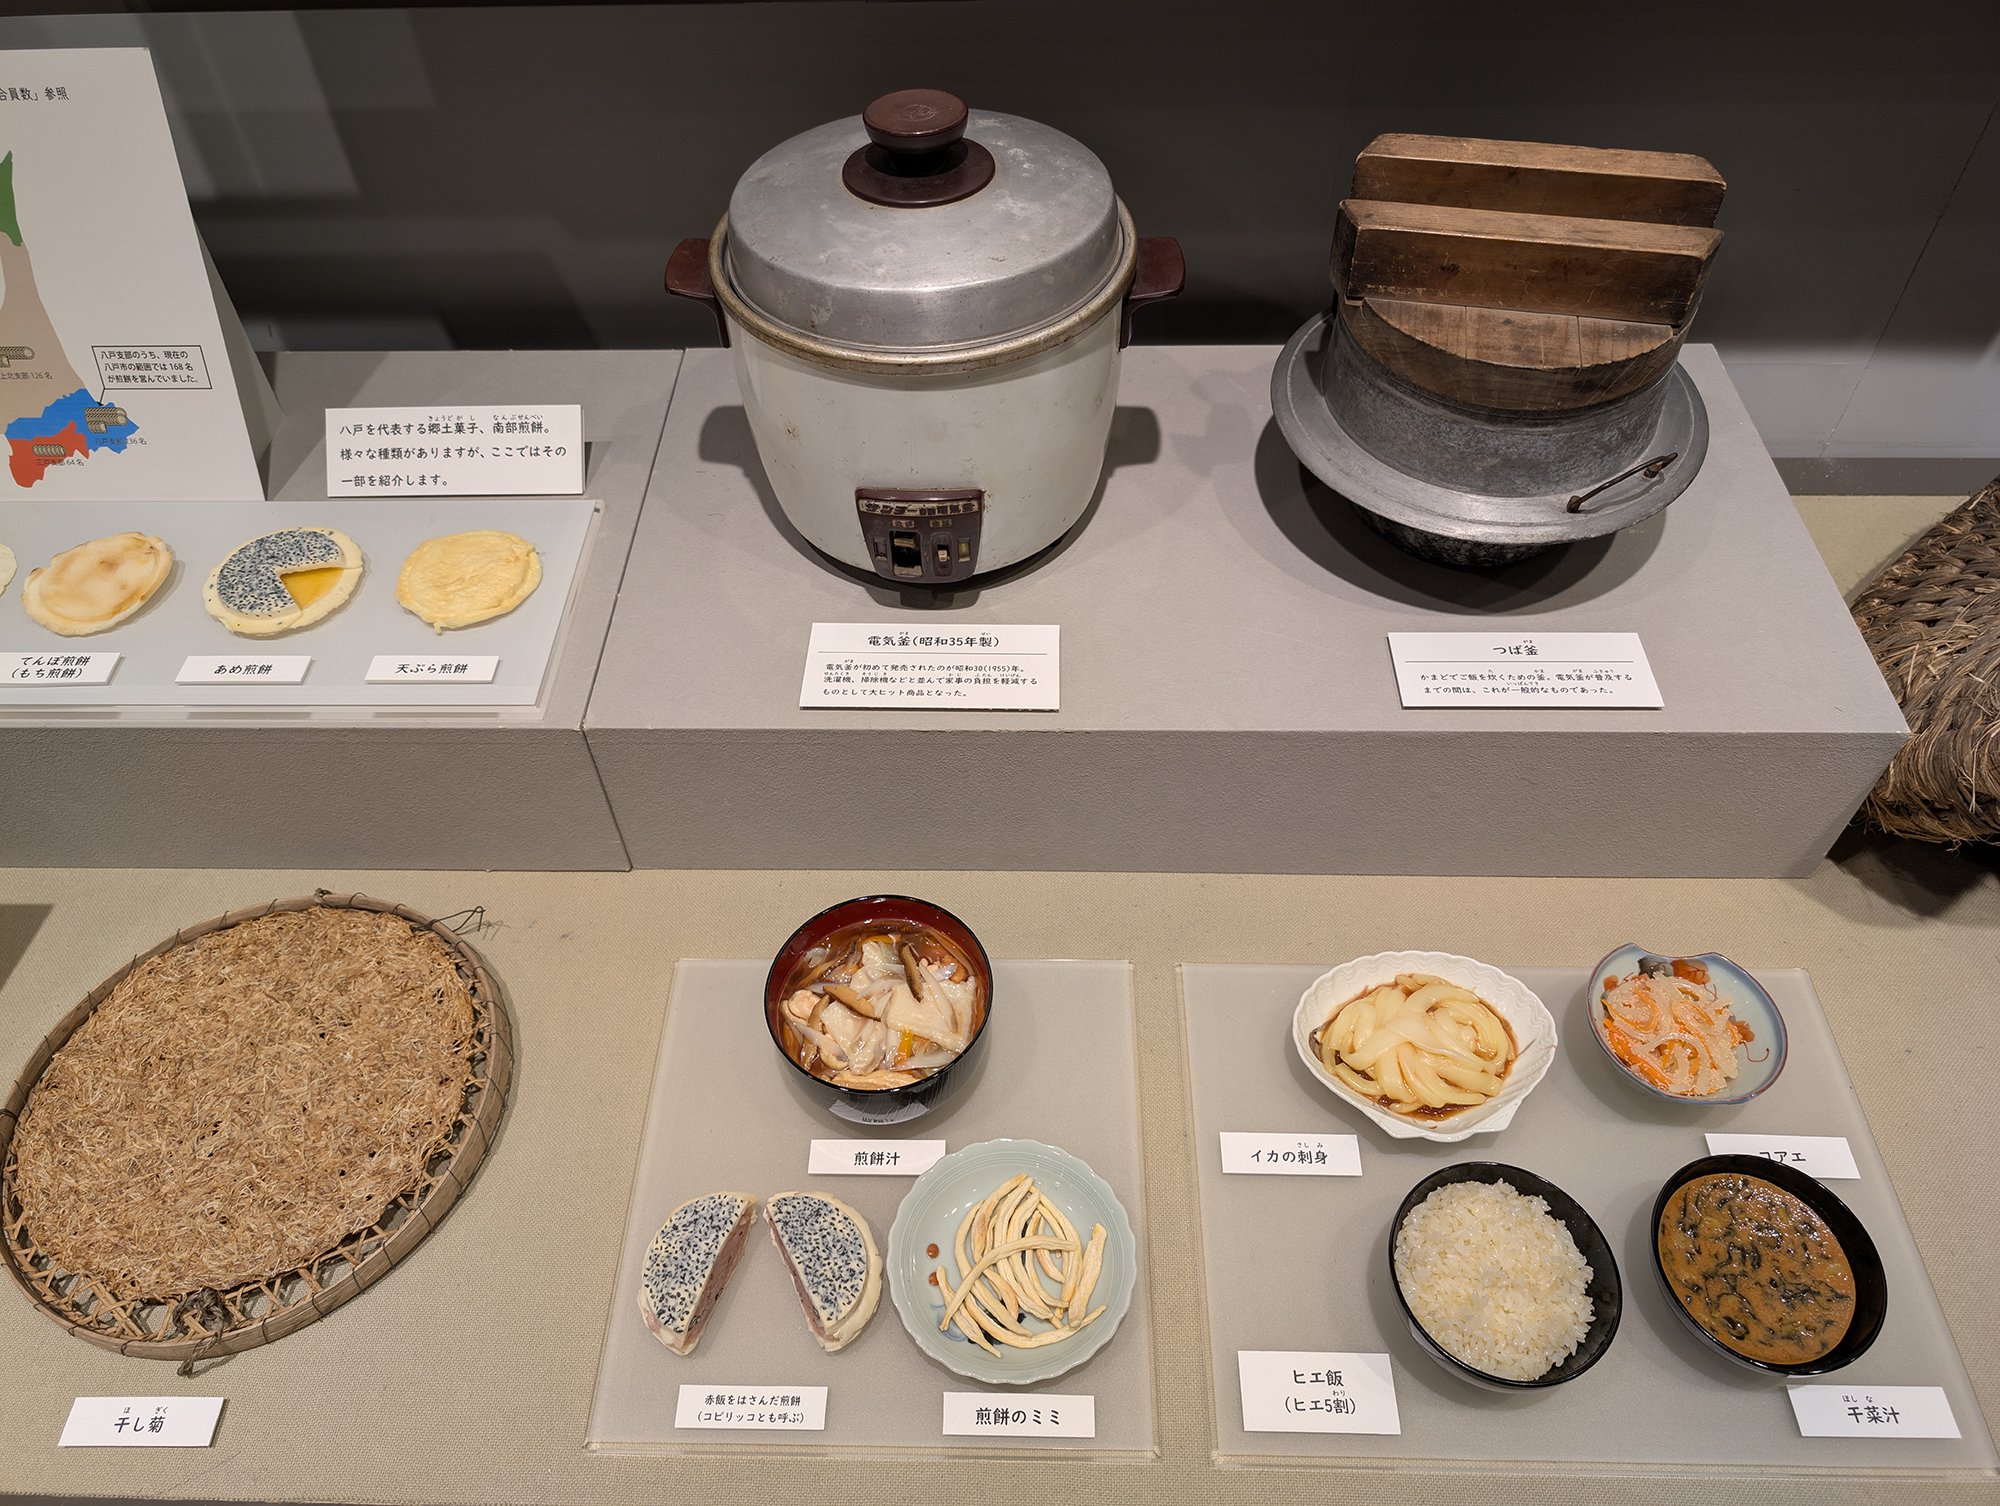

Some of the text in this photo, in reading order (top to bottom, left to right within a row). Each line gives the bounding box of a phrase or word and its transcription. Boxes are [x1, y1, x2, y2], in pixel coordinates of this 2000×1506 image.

[101, 351, 188, 359] 八戸支部のうち、現在の
[340, 445, 567, 461] 様々な種類がありますが、ここではその
[341, 474, 448, 487] 一部を紹介します。
[868, 635, 999, 647] 電気釜(昭和35年製)
[1493, 644, 1538, 656] つば釜
[11, 667, 83, 679] (もち煎餅)
[214, 664, 273, 675] あめ煎餅
[395, 663, 468, 674] 天ぷら煎餅
[825, 664, 1025, 673] 電気釜が初めて発売されたのが昭和30(1955)年。
[1420, 673, 1632, 681] かまどでご飯を炊くための釜。電気釜が普及する
[823, 689, 967, 697] ものとして大ヒット商品となった。
[1424, 686, 1614, 694] までの間は、これが一般的なものであった。
[854, 1151, 900, 1166] 煎餅汁
[1251, 1150, 1328, 1164] イカの刺身
[1293, 1369, 1344, 1387] ヒエ飯
[705, 1394, 801, 1406] 赤飯をはさんだ煎餅
[1285, 1396, 1356, 1415] (ヒエ5割)
[698, 1411, 805, 1424] (コビリッコとも呼ぶ)
[976, 1407, 1059, 1425] 煎餅のミミ
[1847, 1405, 1900, 1424] 干菜汁
[114, 1416, 166, 1433] 干し菊
